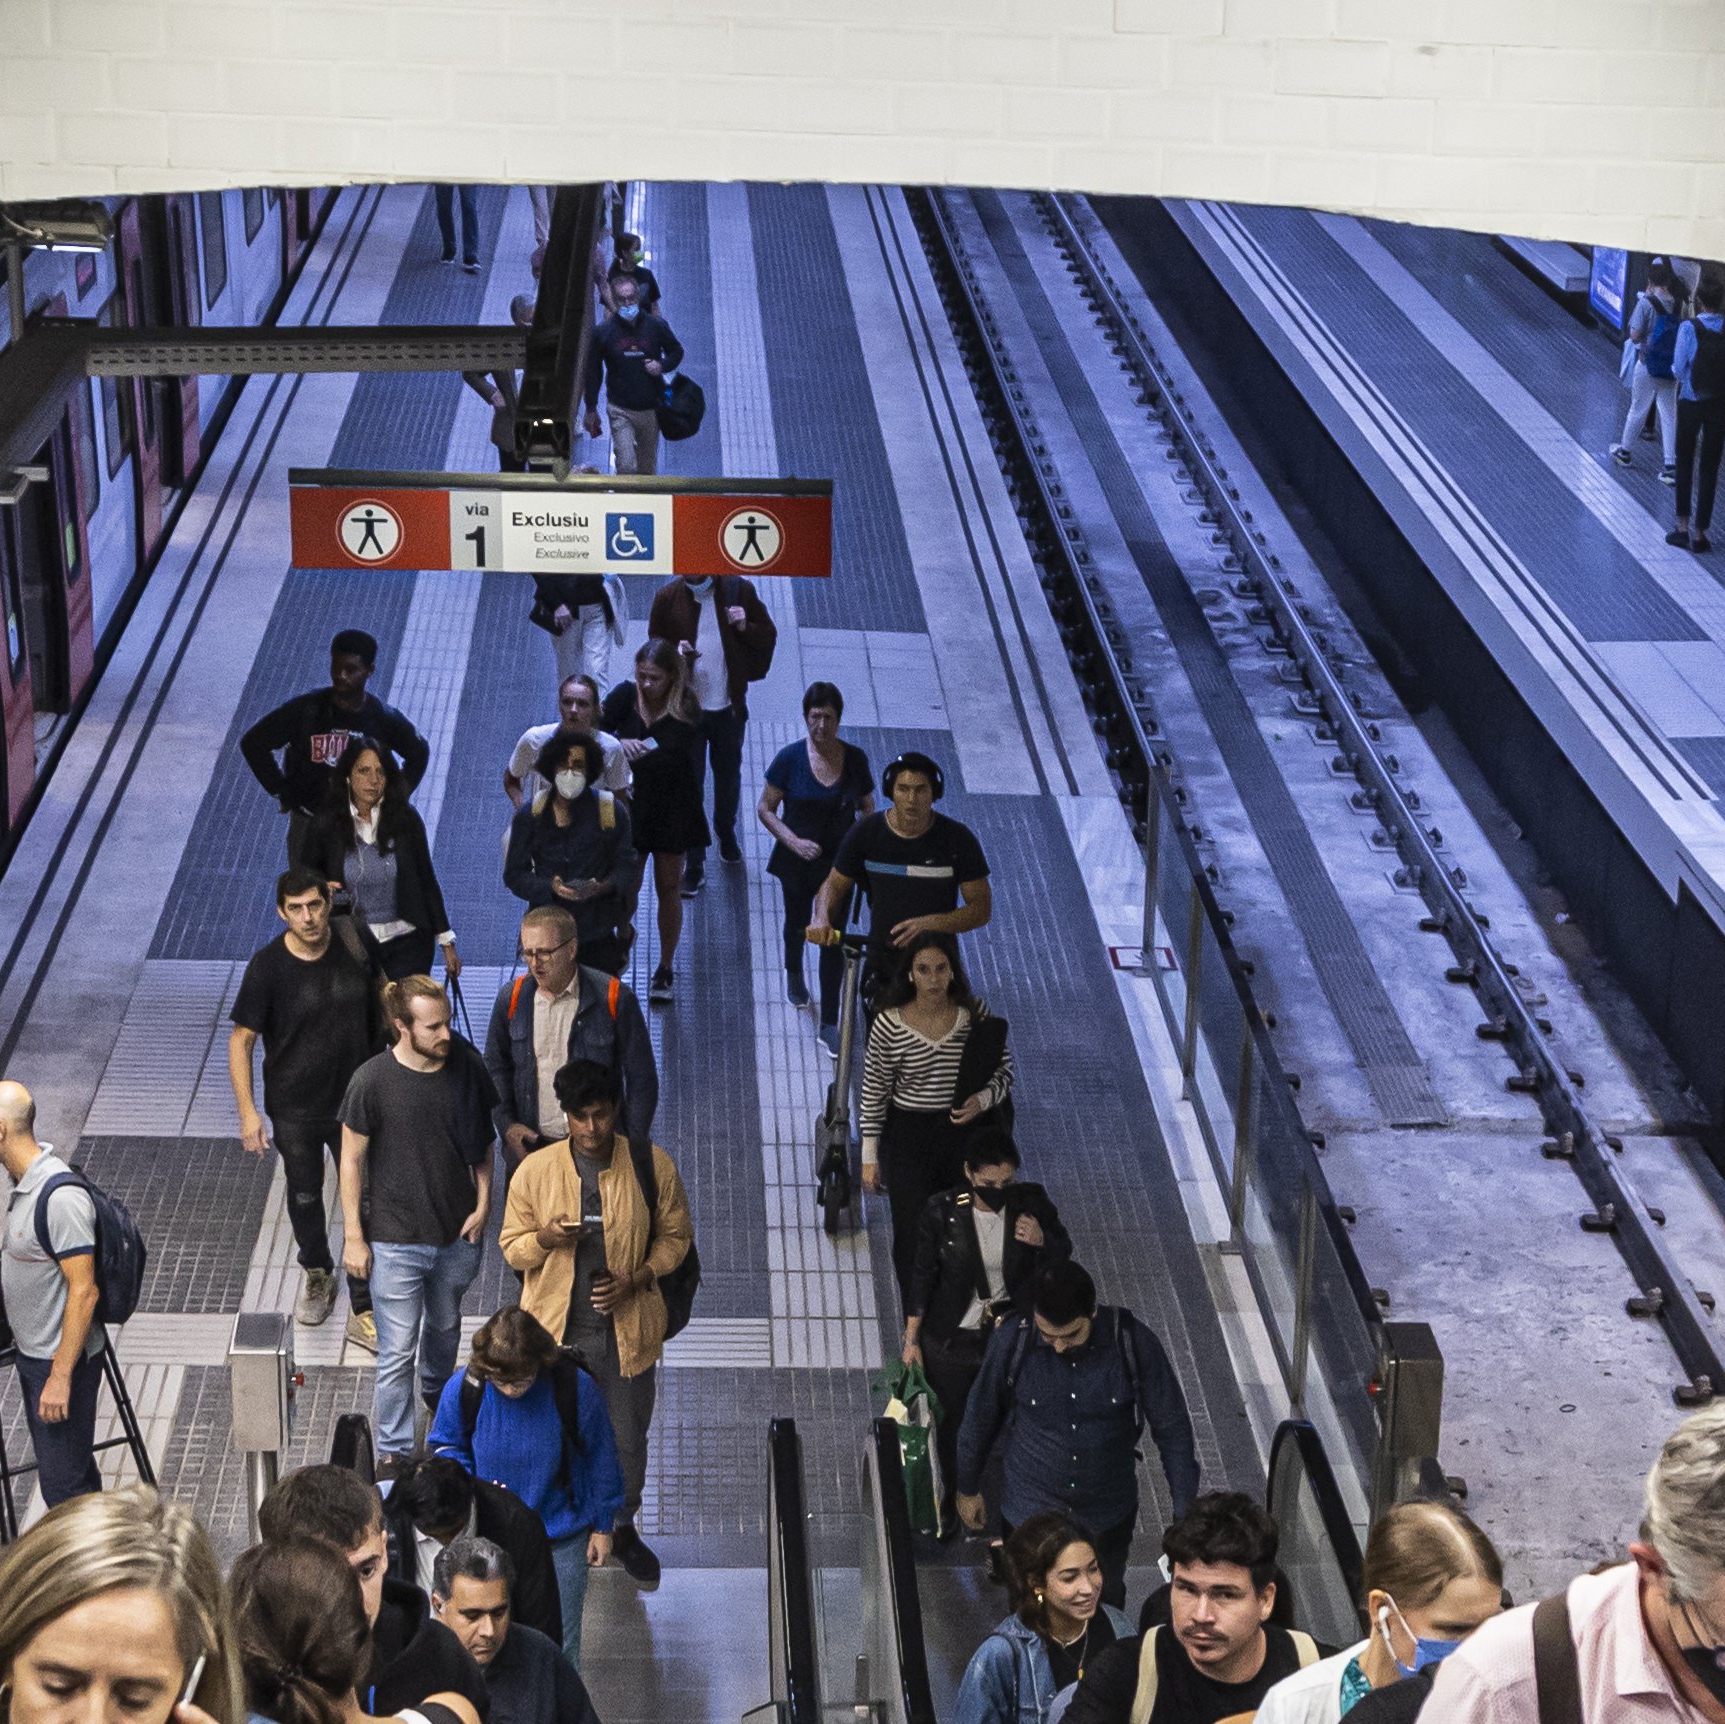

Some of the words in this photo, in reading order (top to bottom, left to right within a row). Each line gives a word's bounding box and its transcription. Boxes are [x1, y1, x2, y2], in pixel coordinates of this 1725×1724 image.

[465, 502, 489, 516] via
[512, 511, 589, 528] Exclusiu
[533, 531, 590, 544] Exclusivo
[465, 525, 486, 568] 1
[535, 547, 590, 560] Exclusive
